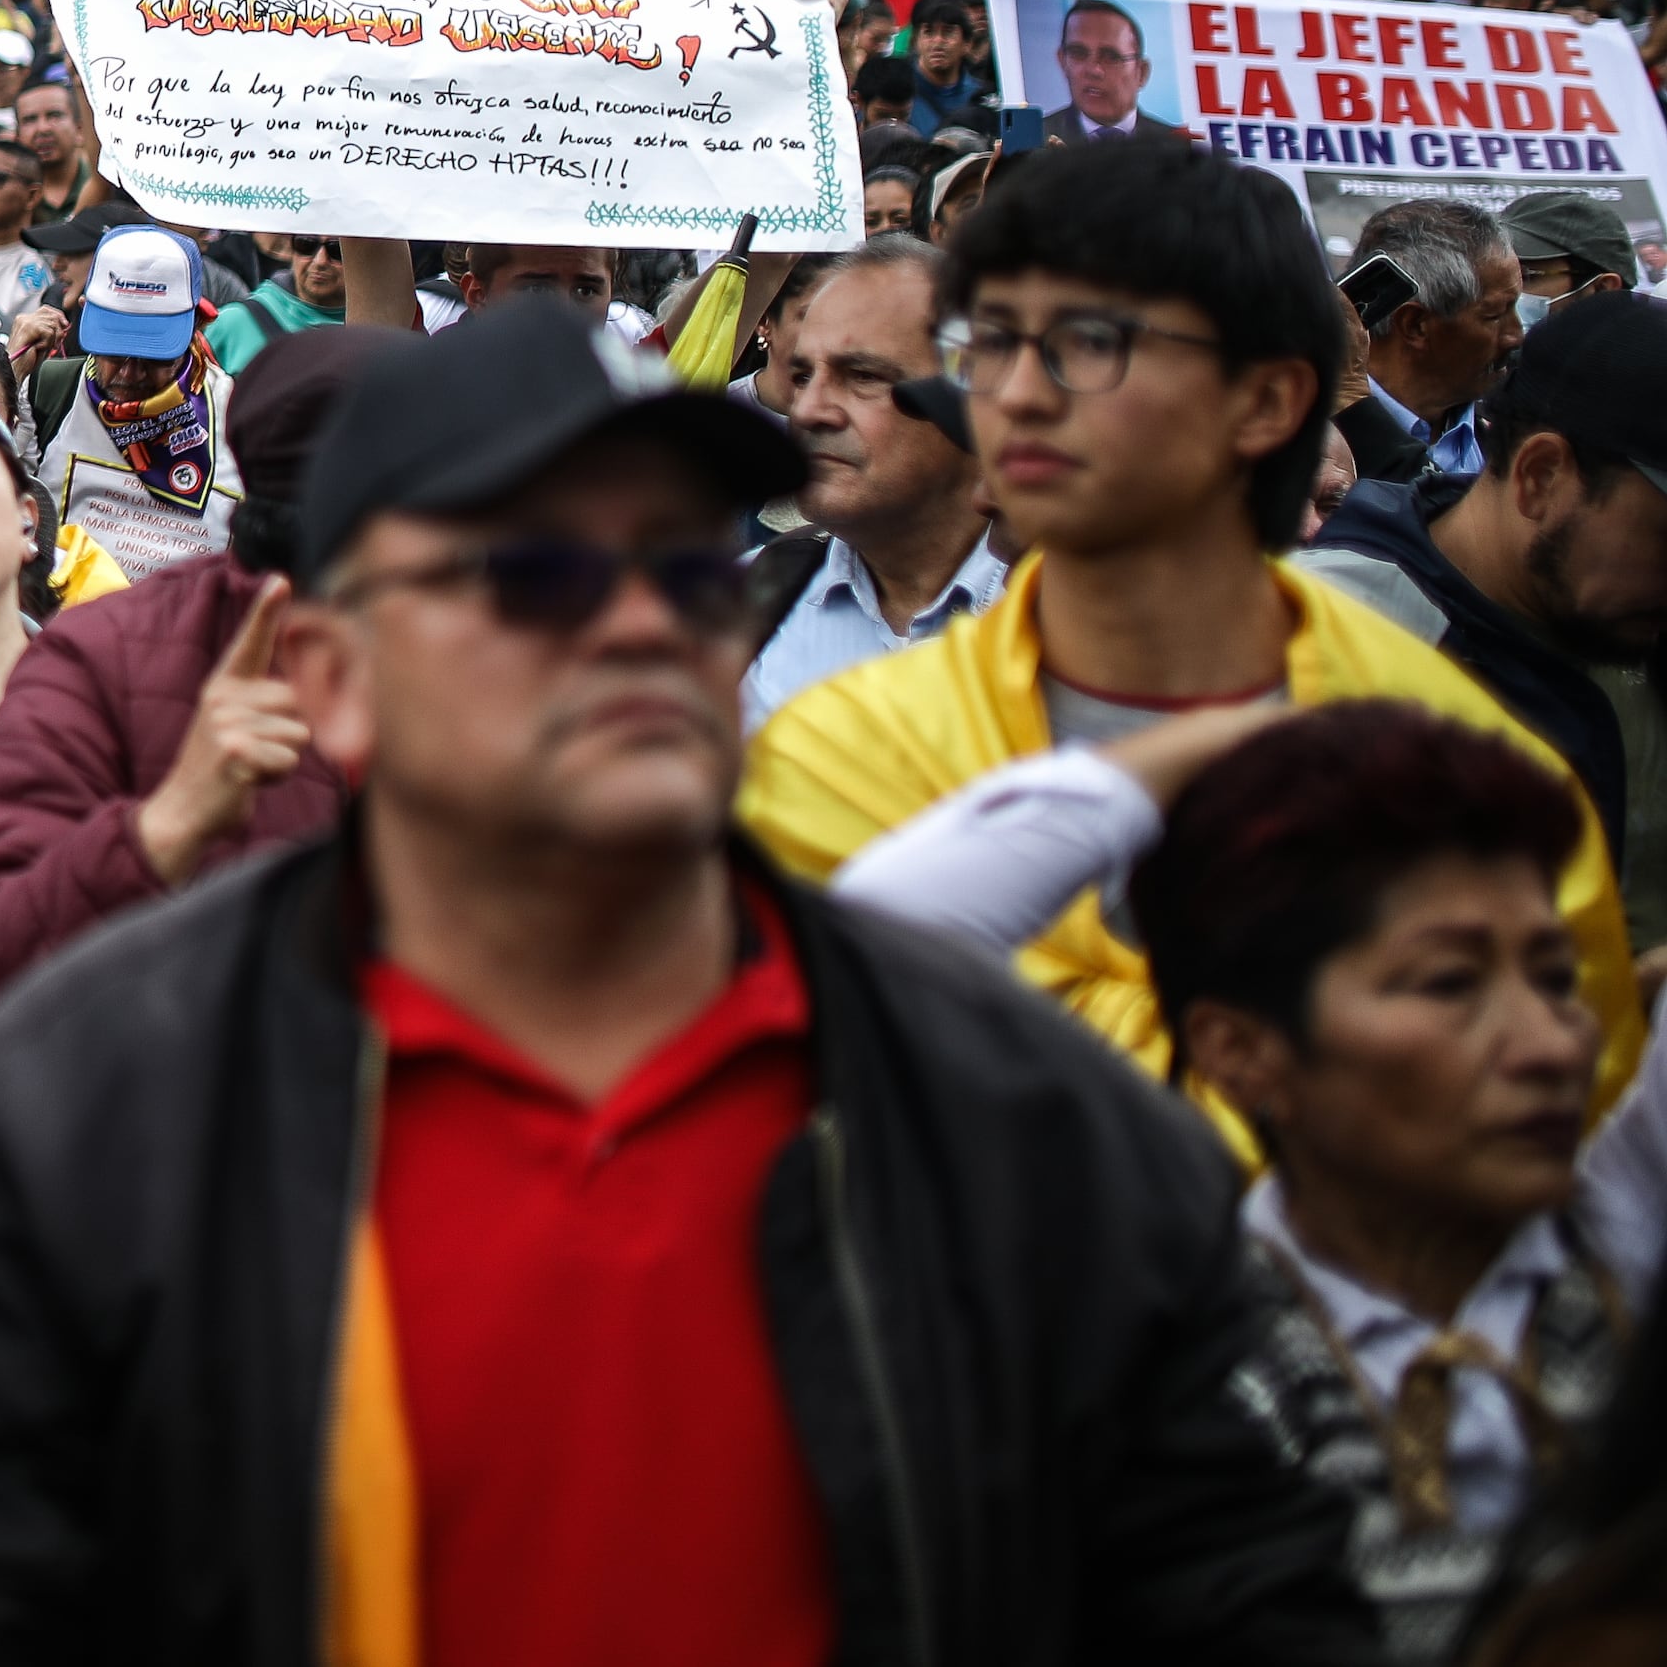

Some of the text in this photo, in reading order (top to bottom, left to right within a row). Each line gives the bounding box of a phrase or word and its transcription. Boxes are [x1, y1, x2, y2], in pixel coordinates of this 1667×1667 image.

[1188, 2, 1591, 77] EL JEFE DE
[89, 56, 135, 93] Por
[147, 77, 191, 111] que
[208, 69, 232, 95] la
[248, 72, 286, 109] ley
[302, 84, 336, 103] por
[340, 74, 376, 103] fin
[389, 90, 423, 107] nos
[1194, 64, 1619, 134] LA BANDA
[135, 112, 224, 139] esfuerzo
[230, 120, 255, 138] y
[266, 119, 302, 132] una
[521, 124, 544, 144] de
[702, 137, 745, 153] sea
[752, 137, 774, 151] no
[778, 136, 807, 151] sea
[1208, 122, 1625, 172] EFRAIN CEPEDA
[267, 147, 298, 161] sea
[308, 148, 333, 162] un
[338, 142, 478, 172] DERECHO
[89, 500, 114, 514] POR
[116, 506, 130, 518] LA
[105, 489, 129, 503] POR
[130, 495, 145, 506] LA
